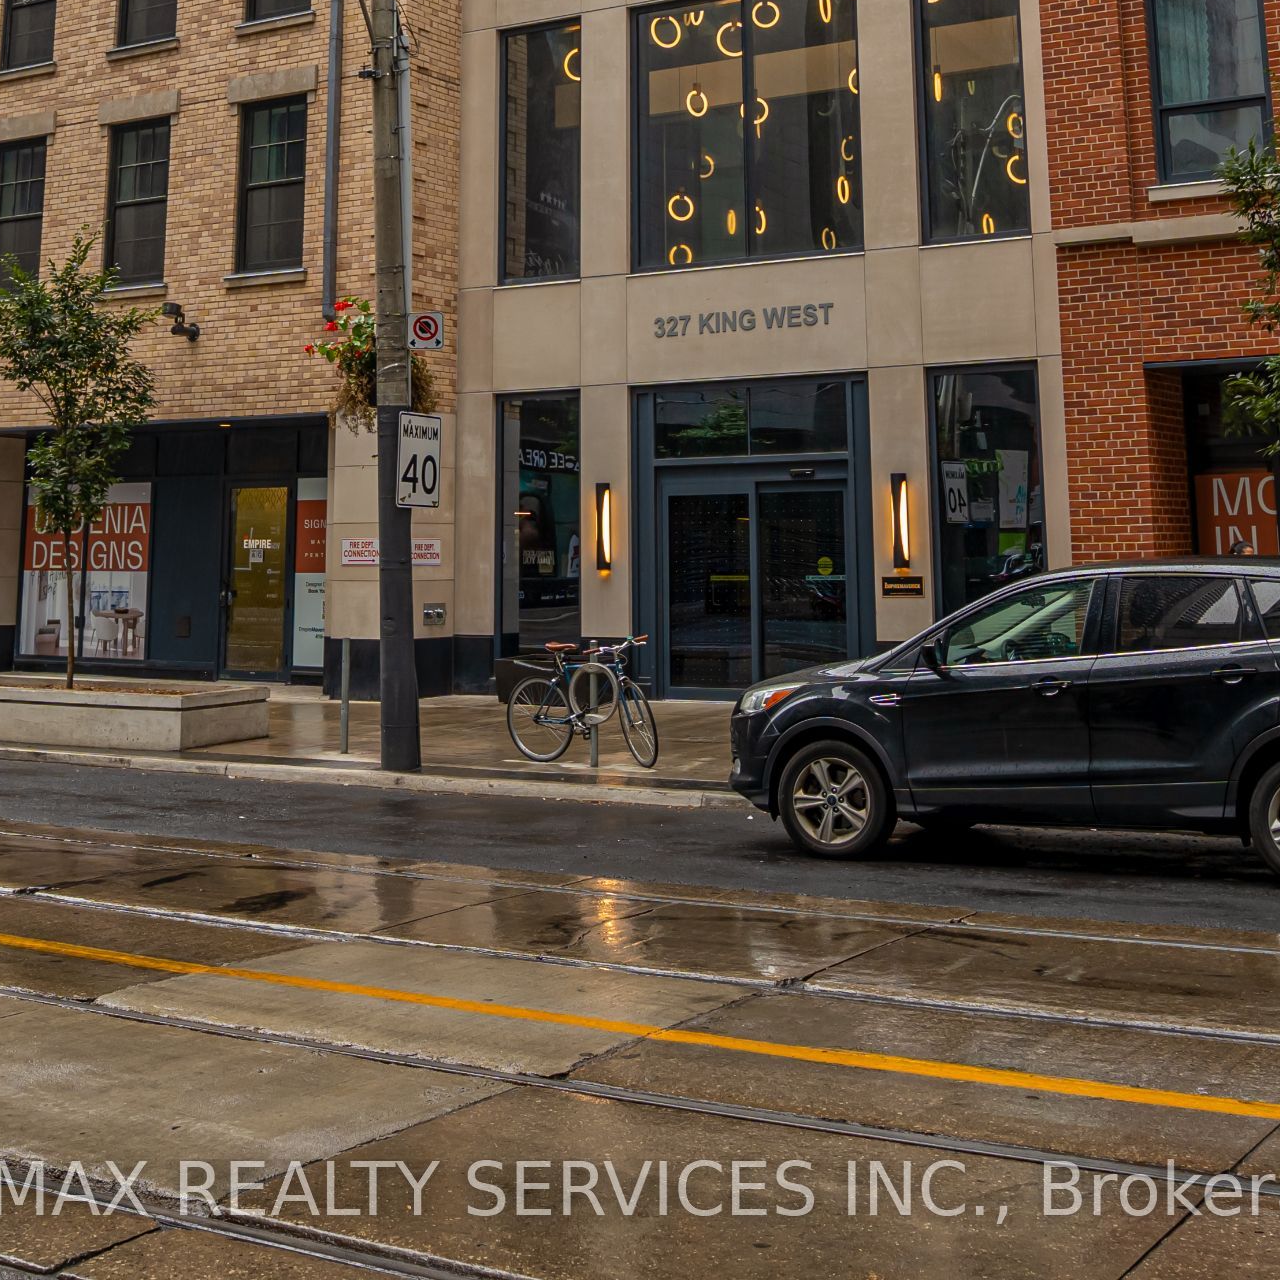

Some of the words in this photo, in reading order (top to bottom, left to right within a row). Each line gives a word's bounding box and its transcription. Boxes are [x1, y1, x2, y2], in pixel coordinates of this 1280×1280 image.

[654, 315, 691, 338] 327
[699, 309, 756, 335] KING
[762, 302, 834, 329] WEST
[402, 423, 439, 441] MAXIMUM
[401, 453, 437, 495] 40
[243, 539, 272, 549] EMPIRE
[349, 541, 360, 549] FIRE
[361, 541, 374, 549] DEPT.
[414, 543, 423, 552] FIRE
[32, 540, 144, 569] DESIGNS
